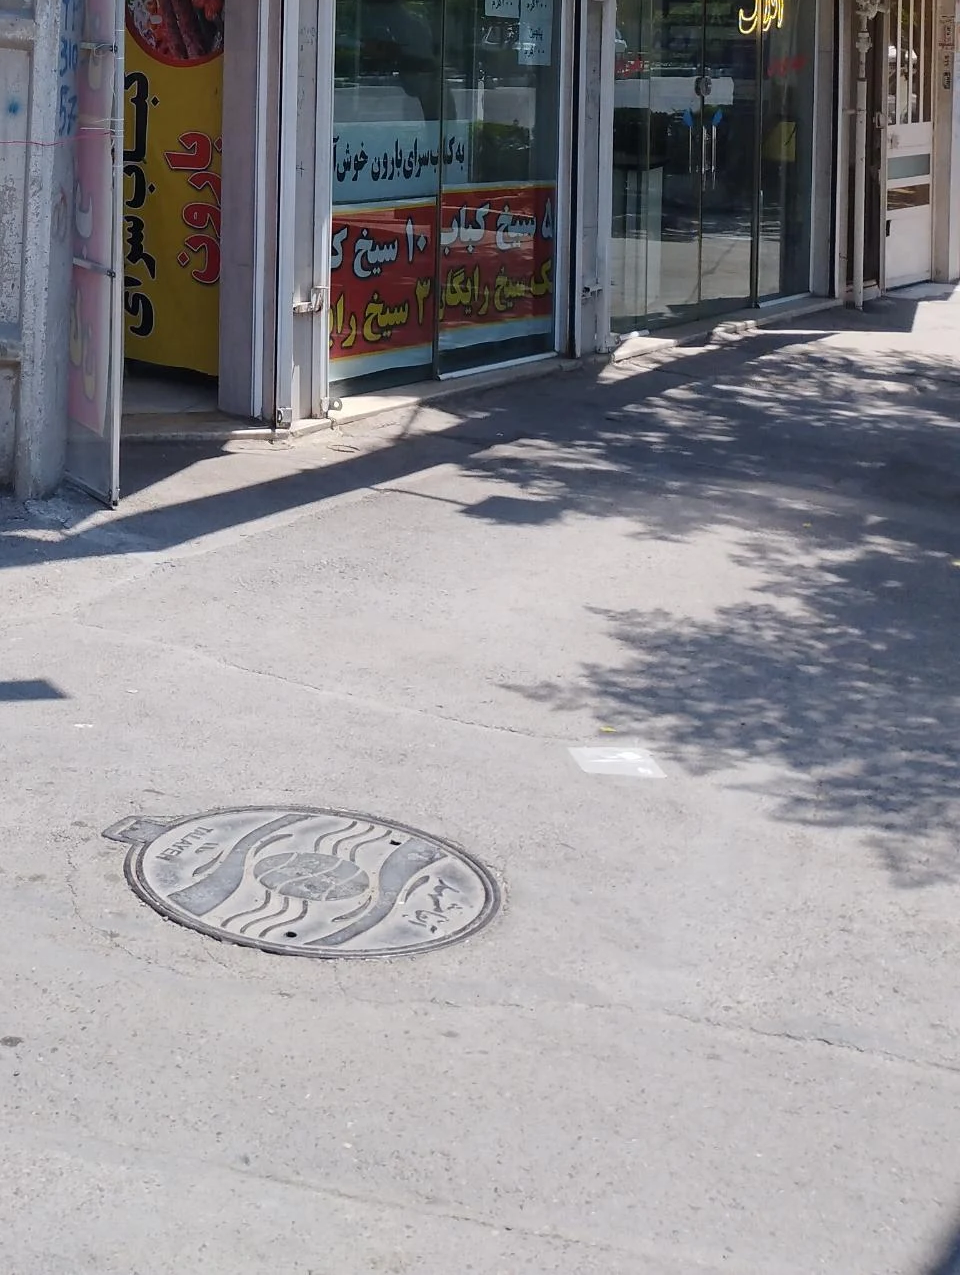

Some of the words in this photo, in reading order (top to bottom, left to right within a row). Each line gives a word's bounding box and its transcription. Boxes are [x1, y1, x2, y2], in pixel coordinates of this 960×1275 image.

[336, 141, 369, 183] خوش
[371, 137, 403, 182] بارون
[403, 137, 430, 179] سرای
[440, 202, 490, 256] کباب
[495, 203, 537, 251] سیخ
[353, 227, 399, 279] سیخ
[493, 266, 527, 311] سیخ
[363, 291, 409, 343] سیخ
